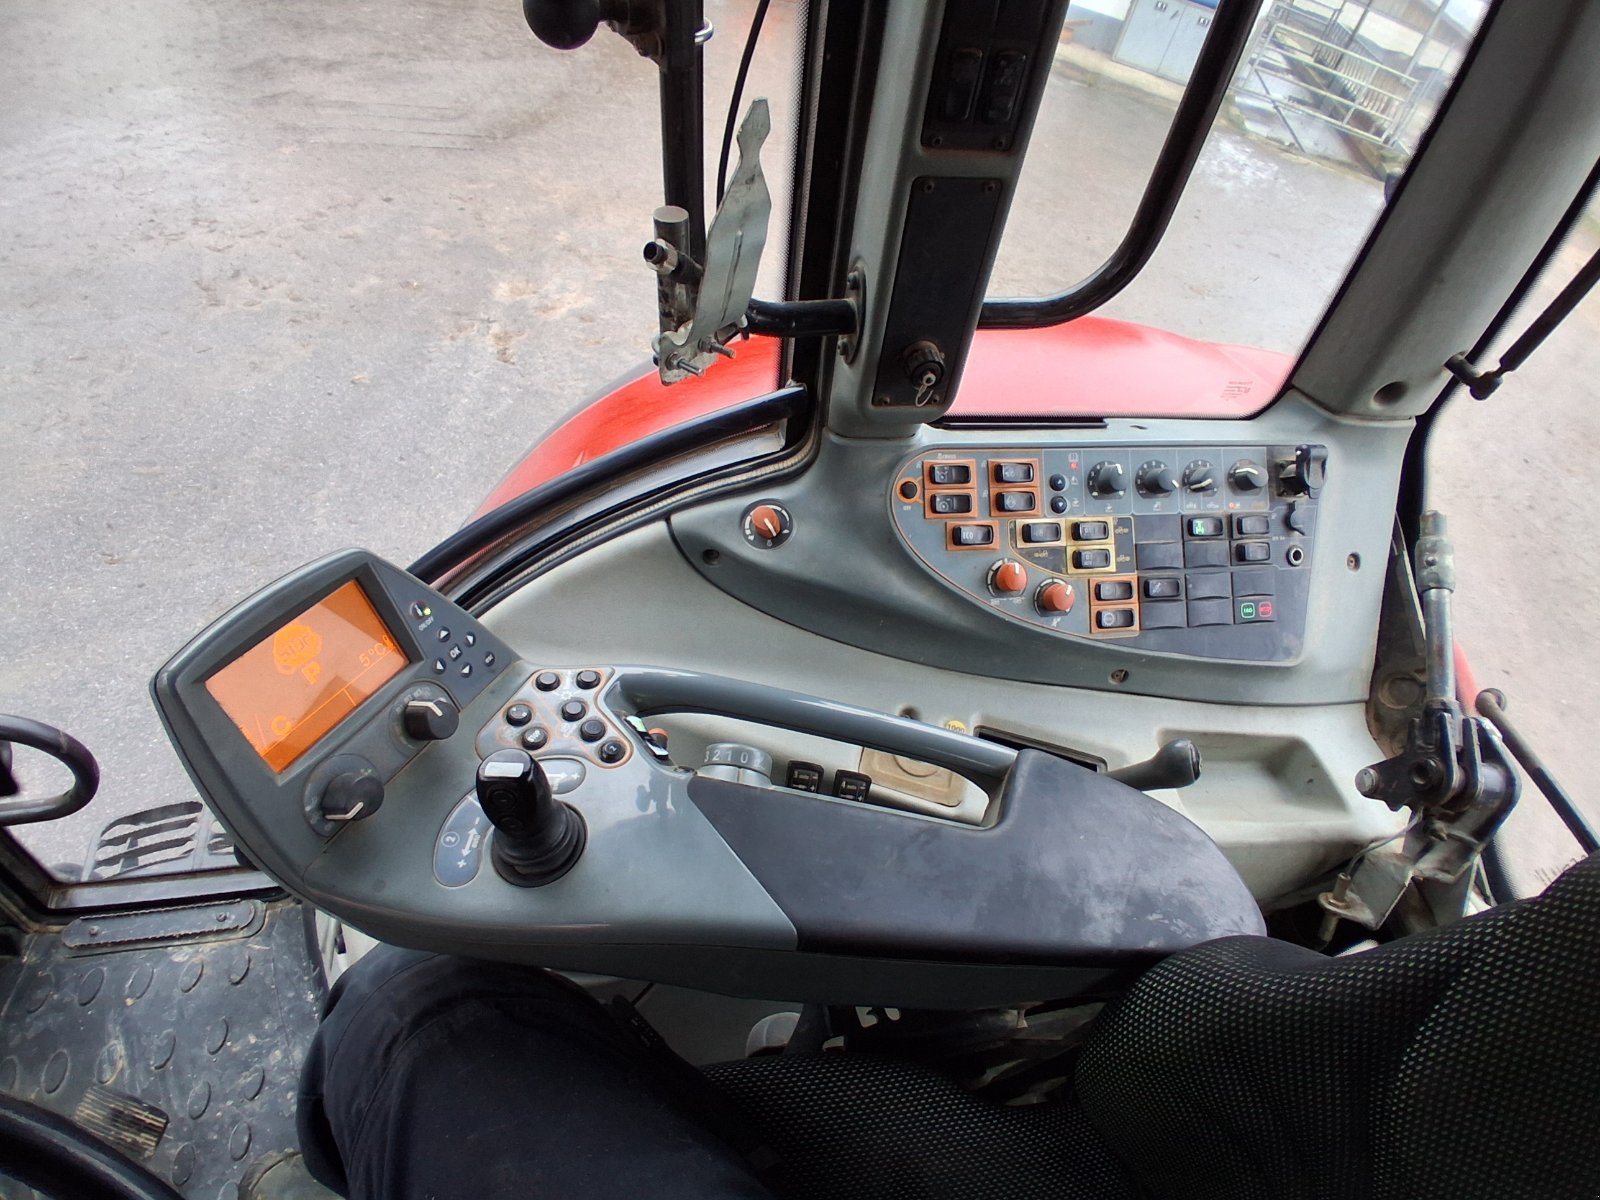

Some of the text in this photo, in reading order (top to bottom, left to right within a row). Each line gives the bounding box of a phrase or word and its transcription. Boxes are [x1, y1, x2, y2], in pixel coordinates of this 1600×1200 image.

[962, 531, 974, 540] ECO
[449, 646, 462, 658] OK
[303, 662, 321, 685] P
